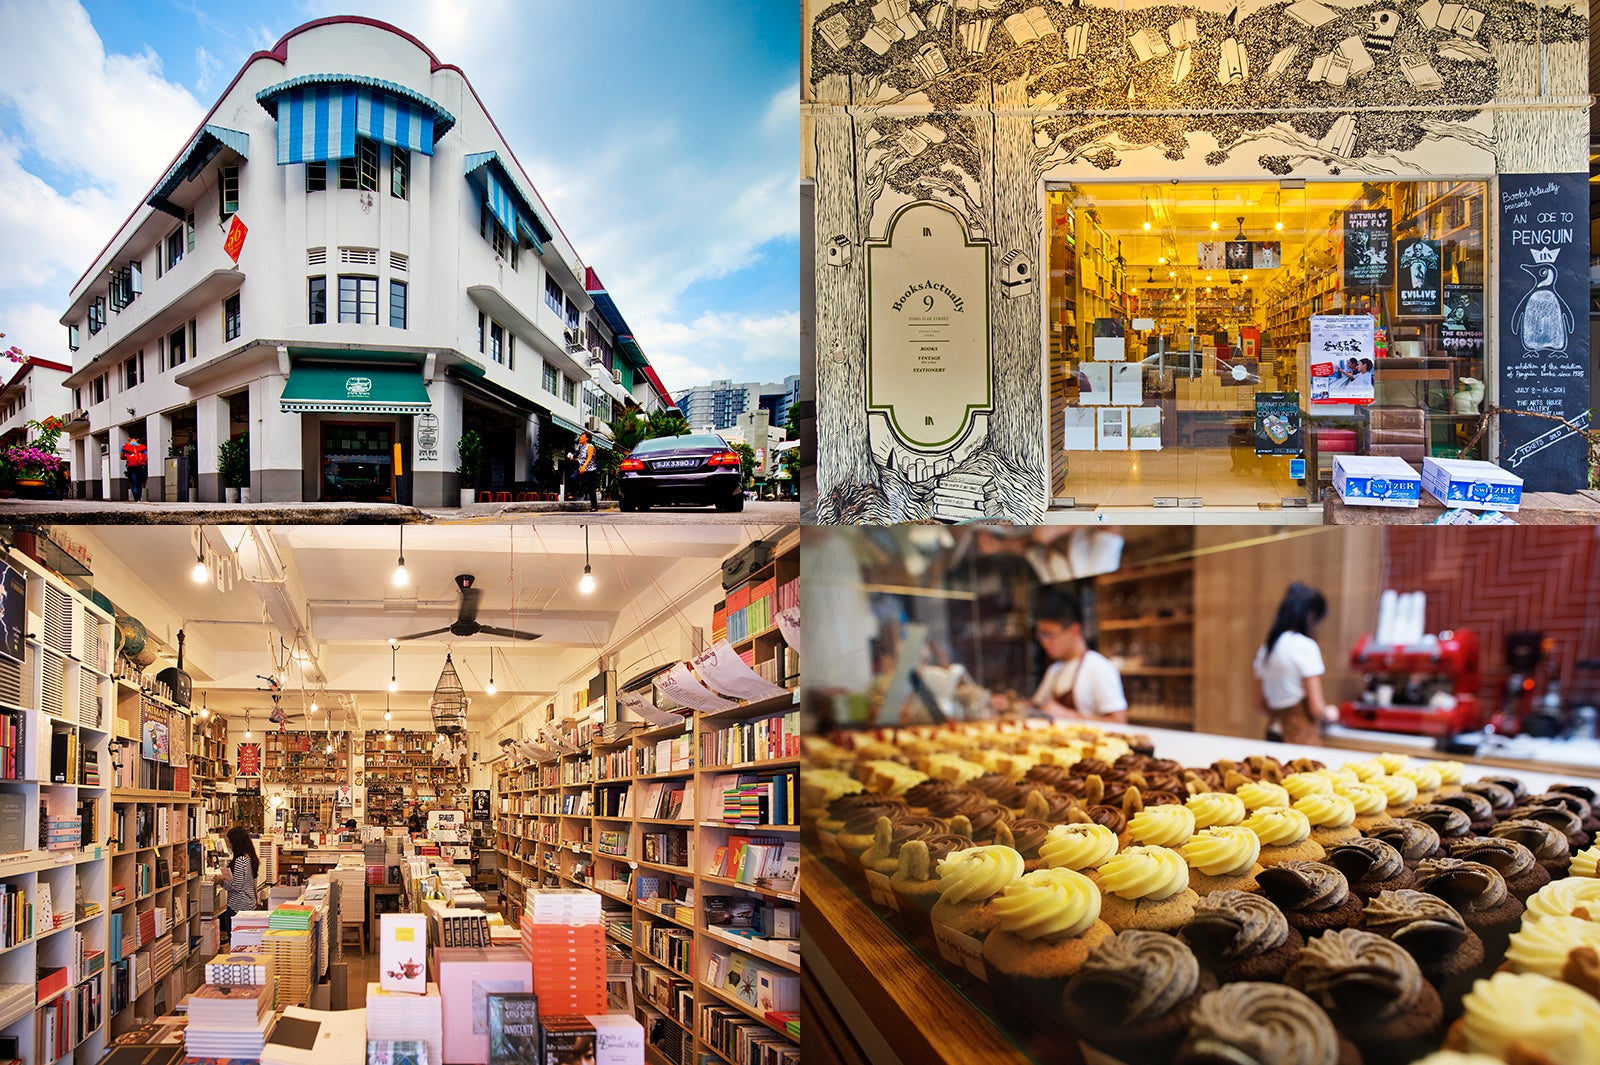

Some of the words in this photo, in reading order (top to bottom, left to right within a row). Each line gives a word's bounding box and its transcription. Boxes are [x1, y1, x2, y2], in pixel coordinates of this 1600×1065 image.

[1502, 182, 1560, 203] BooksActually
[1504, 198, 1532, 213] presents
[1349, 220, 1368, 228] THE
[1371, 219, 1388, 228] FLY
[1513, 213, 1527, 224] AN
[1537, 212, 1557, 223] ODE
[1560, 212, 1574, 223] TO
[1512, 228, 1573, 245] PENGUIN
[892, 280, 965, 313] BooksActually
[1401, 290, 1437, 300] EVILIVE
[923, 295, 934, 312] 9
[1443, 337, 1484, 348] GHOST
[1540, 363, 1547, 373] of
[1515, 371, 1538, 380] Penguin
[1520, 439, 1545, 455] TICKETS
[1549, 430, 1562, 441] SOLD
[1372, 482, 1414, 490] SWITZER
[1474, 486, 1515, 495] SWITZER
[504, 1024, 534, 1037] INNOCENTS
[546, 1043, 557, 1051] MY
